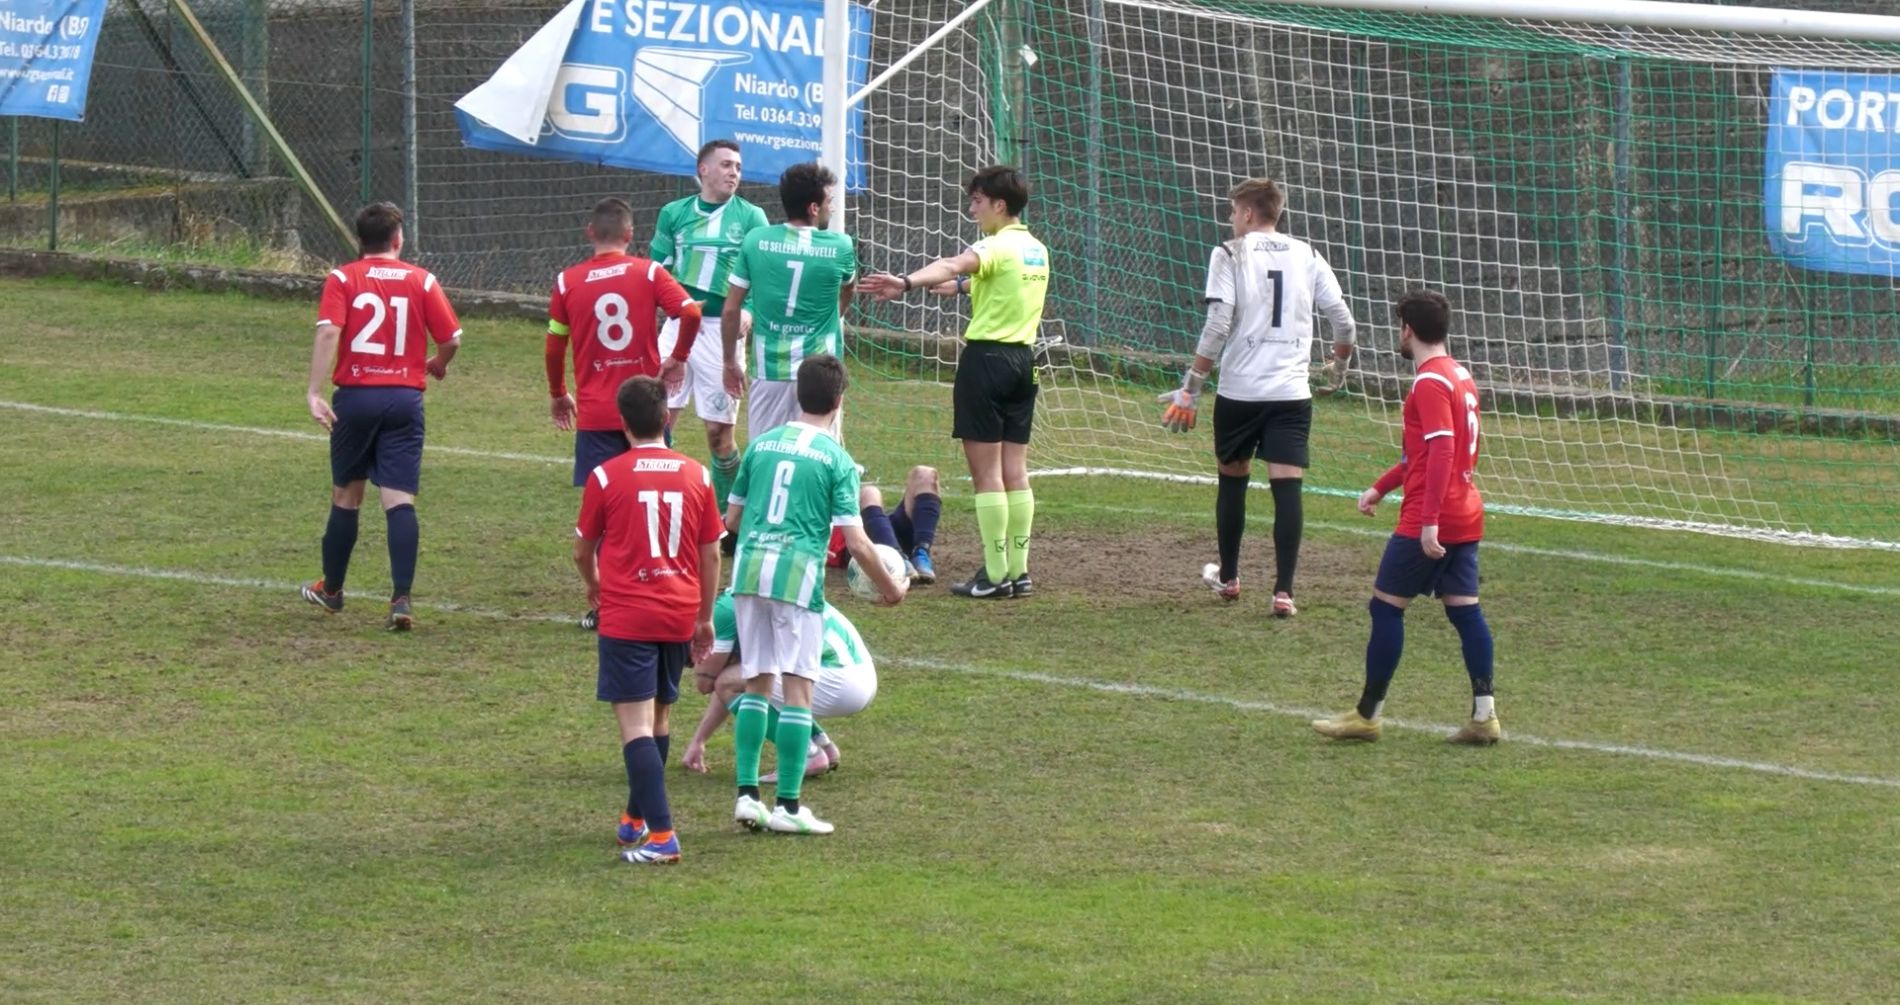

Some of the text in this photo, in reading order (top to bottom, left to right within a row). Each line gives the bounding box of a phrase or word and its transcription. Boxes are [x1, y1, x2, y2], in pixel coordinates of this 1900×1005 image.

[0, 11, 54, 35] Niardo
[0, 41, 20, 57] Tel.
[625, 0, 850, 57] SEZIONAL
[545, 63, 620, 138] G
[735, 72, 823, 108] Niardo (B
[735, 104, 822, 128] Tel. 0364.339
[785, 260, 804, 317] 7
[1267, 270, 1283, 328] 1
[351, 292, 408, 356] 21
[594, 292, 633, 351] 8
[767, 460, 796, 525] 6
[638, 490, 683, 558] 11
